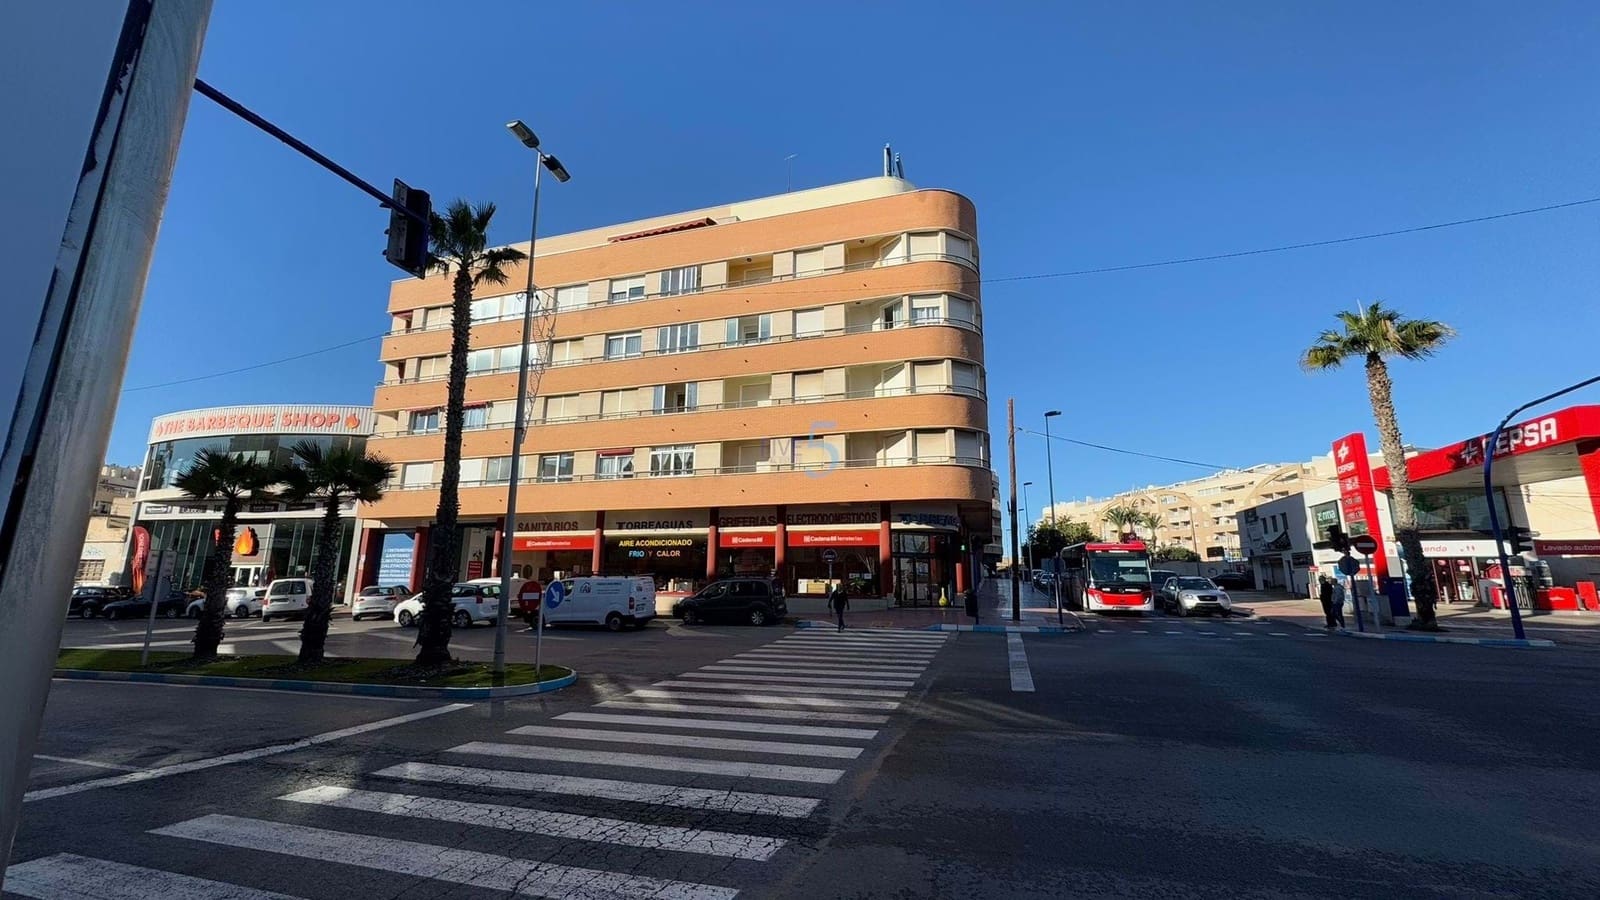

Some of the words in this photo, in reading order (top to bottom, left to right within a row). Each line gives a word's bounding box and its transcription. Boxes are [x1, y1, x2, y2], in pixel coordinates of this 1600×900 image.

[164, 419, 186, 435] THE
[187, 412, 276, 431] BARBEQUE
[282, 412, 341, 428] SHOP
[518, 520, 579, 532] SANITARIOS
[616, 520, 693, 531] TORREAGUAS
[720, 514, 777, 527] GRIFERIAS
[635, 539, 693, 547] ACONDICIONADO
[628, 550, 645, 558] FRIO
